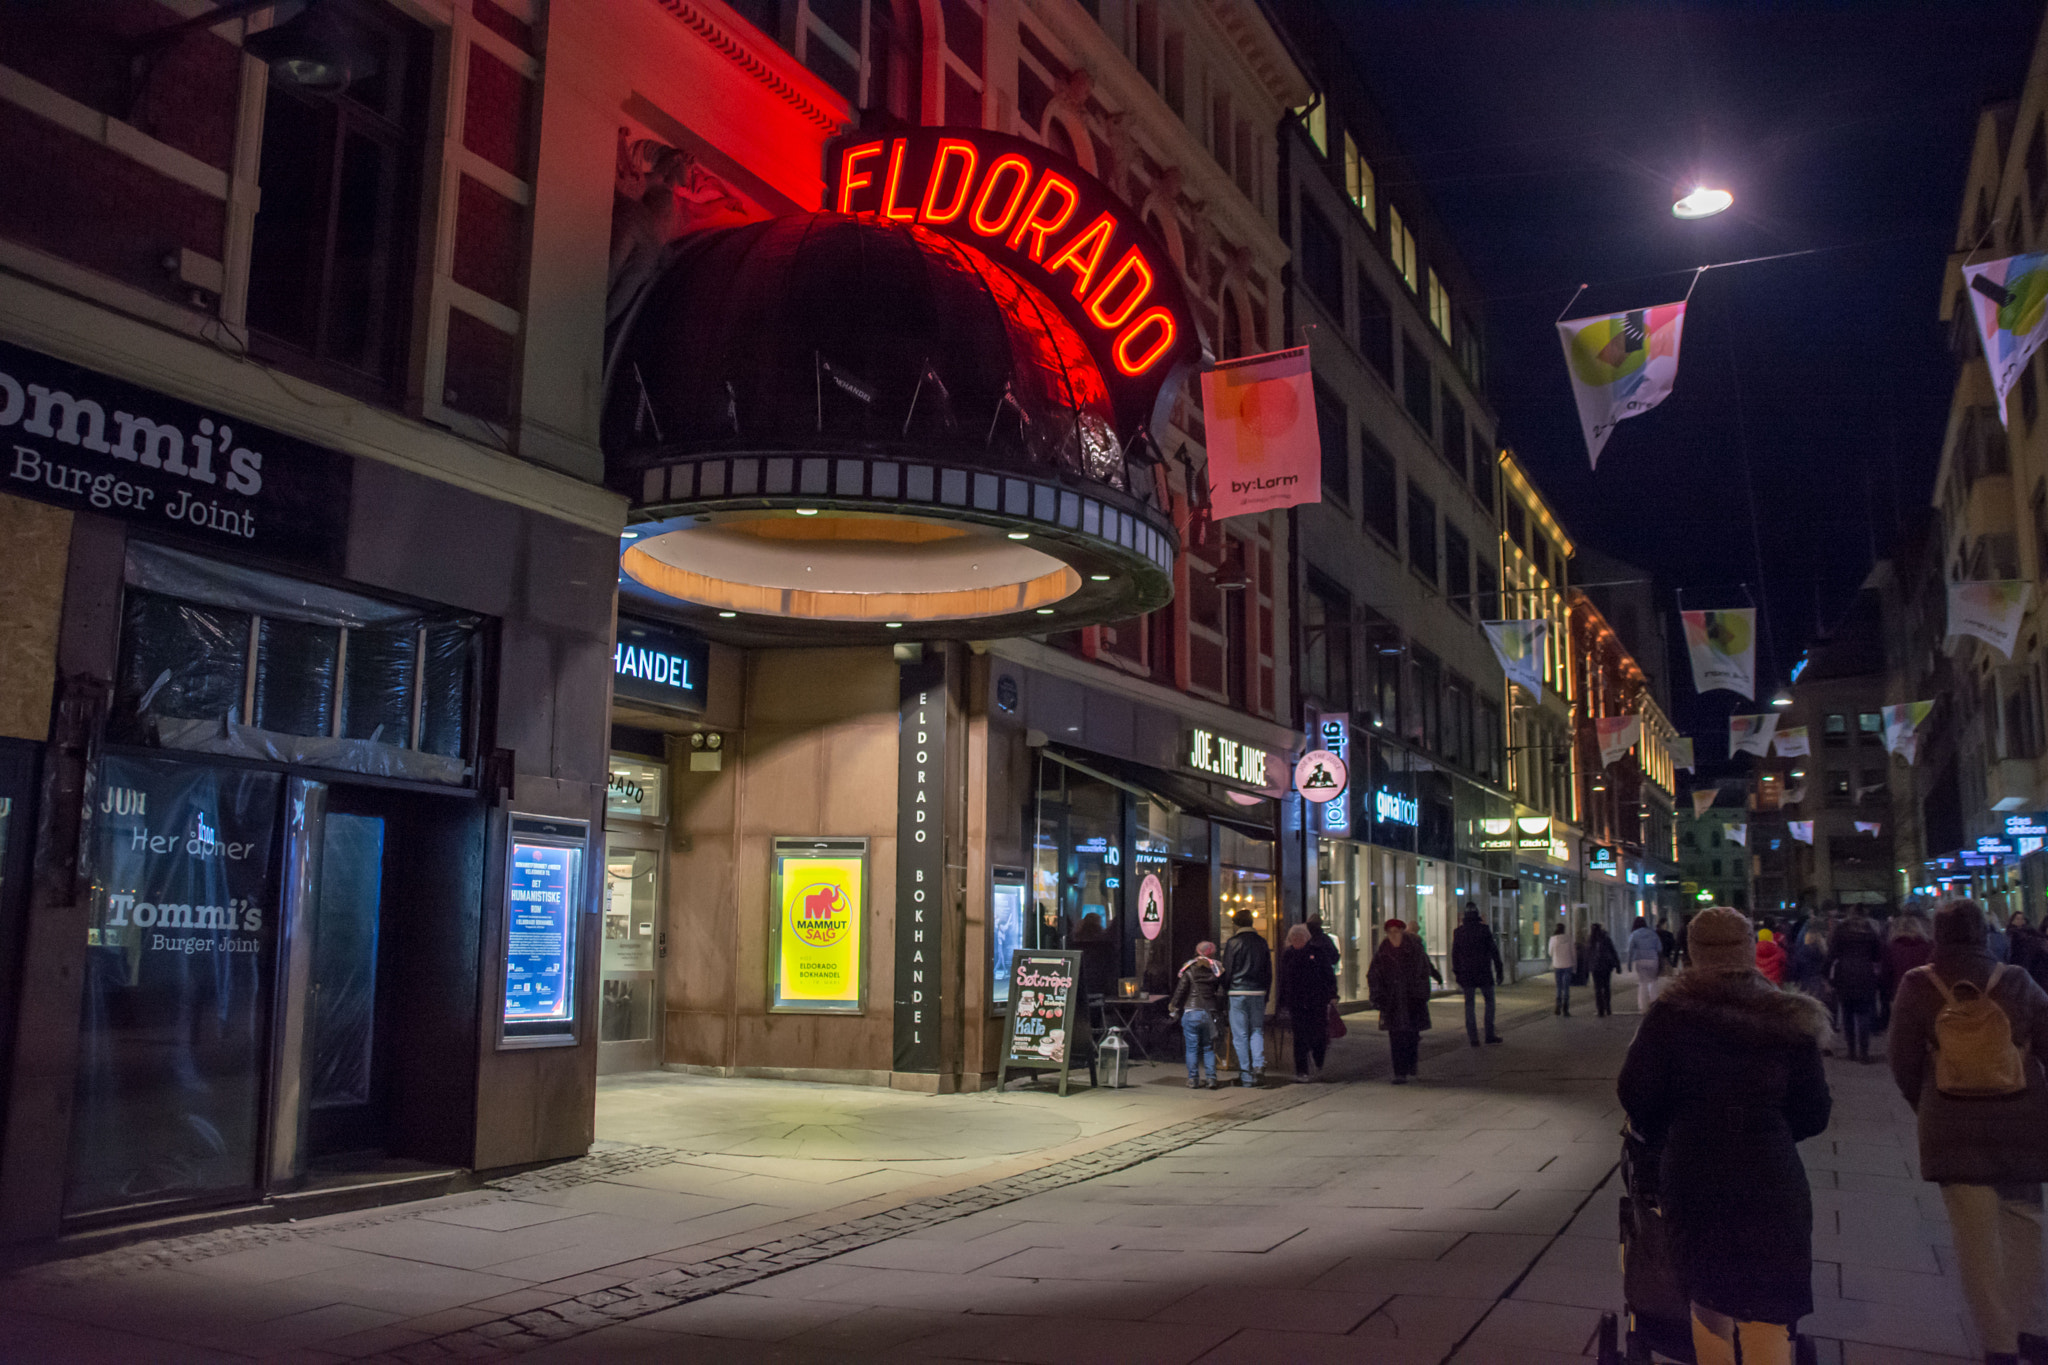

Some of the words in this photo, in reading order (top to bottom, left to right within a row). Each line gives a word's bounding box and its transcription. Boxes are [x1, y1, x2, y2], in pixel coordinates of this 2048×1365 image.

[837, 138, 1177, 377] ELDORADO
[10, 444, 155, 511] Burger
[165, 489, 256, 538] Joint
[1231, 474, 1299, 494] by:Larm
[914, 692, 929, 843] ELDORADO
[1190, 728, 1213, 772] JOE
[1212, 759, 1221, 774] &
[1217, 736, 1240, 779] THE
[1239, 744, 1268, 787] JUICE
[131, 826, 180, 854] Her
[511, 889, 561, 903] HUMANISTISKE
[106, 893, 263, 932] Tommi's
[796, 920, 847, 930] MAMMUT
[151, 934, 215, 955] Burger
[218, 935, 261, 953] Joint
[805, 927, 836, 942] SALG
[912, 869, 926, 1044] BOKHANDEL
[799, 971, 841, 979] BOKHANDEL
